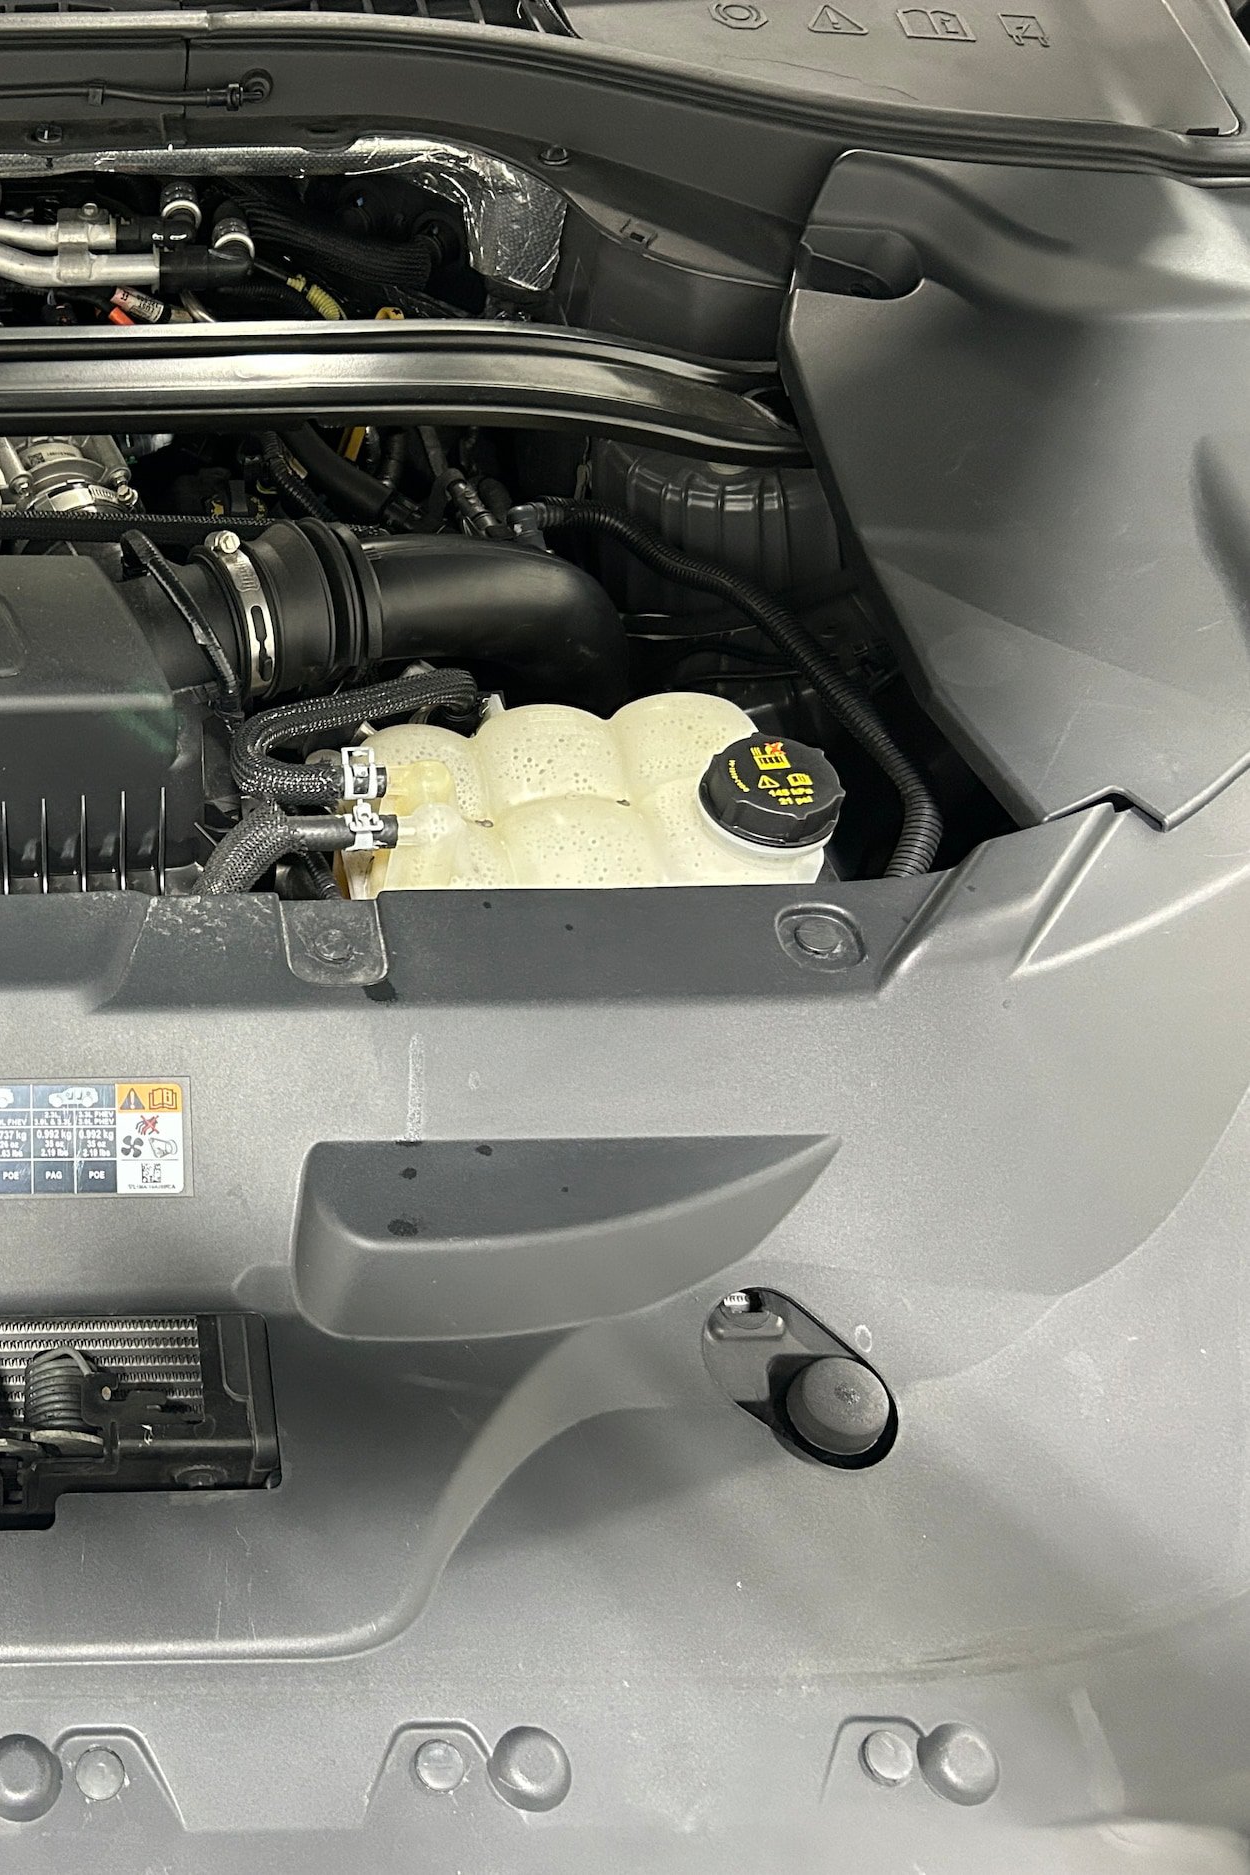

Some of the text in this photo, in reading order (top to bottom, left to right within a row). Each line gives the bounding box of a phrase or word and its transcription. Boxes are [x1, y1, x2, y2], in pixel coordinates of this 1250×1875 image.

[16, 1130, 27, 1142] kg
[36, 1129, 72, 1141] 0.992 kg
[78, 1129, 114, 1141] 0.992 kg
[2, 1171, 20, 1180] POE
[45, 1171, 62, 1180] PAG
[88, 1171, 105, 1179] POE
